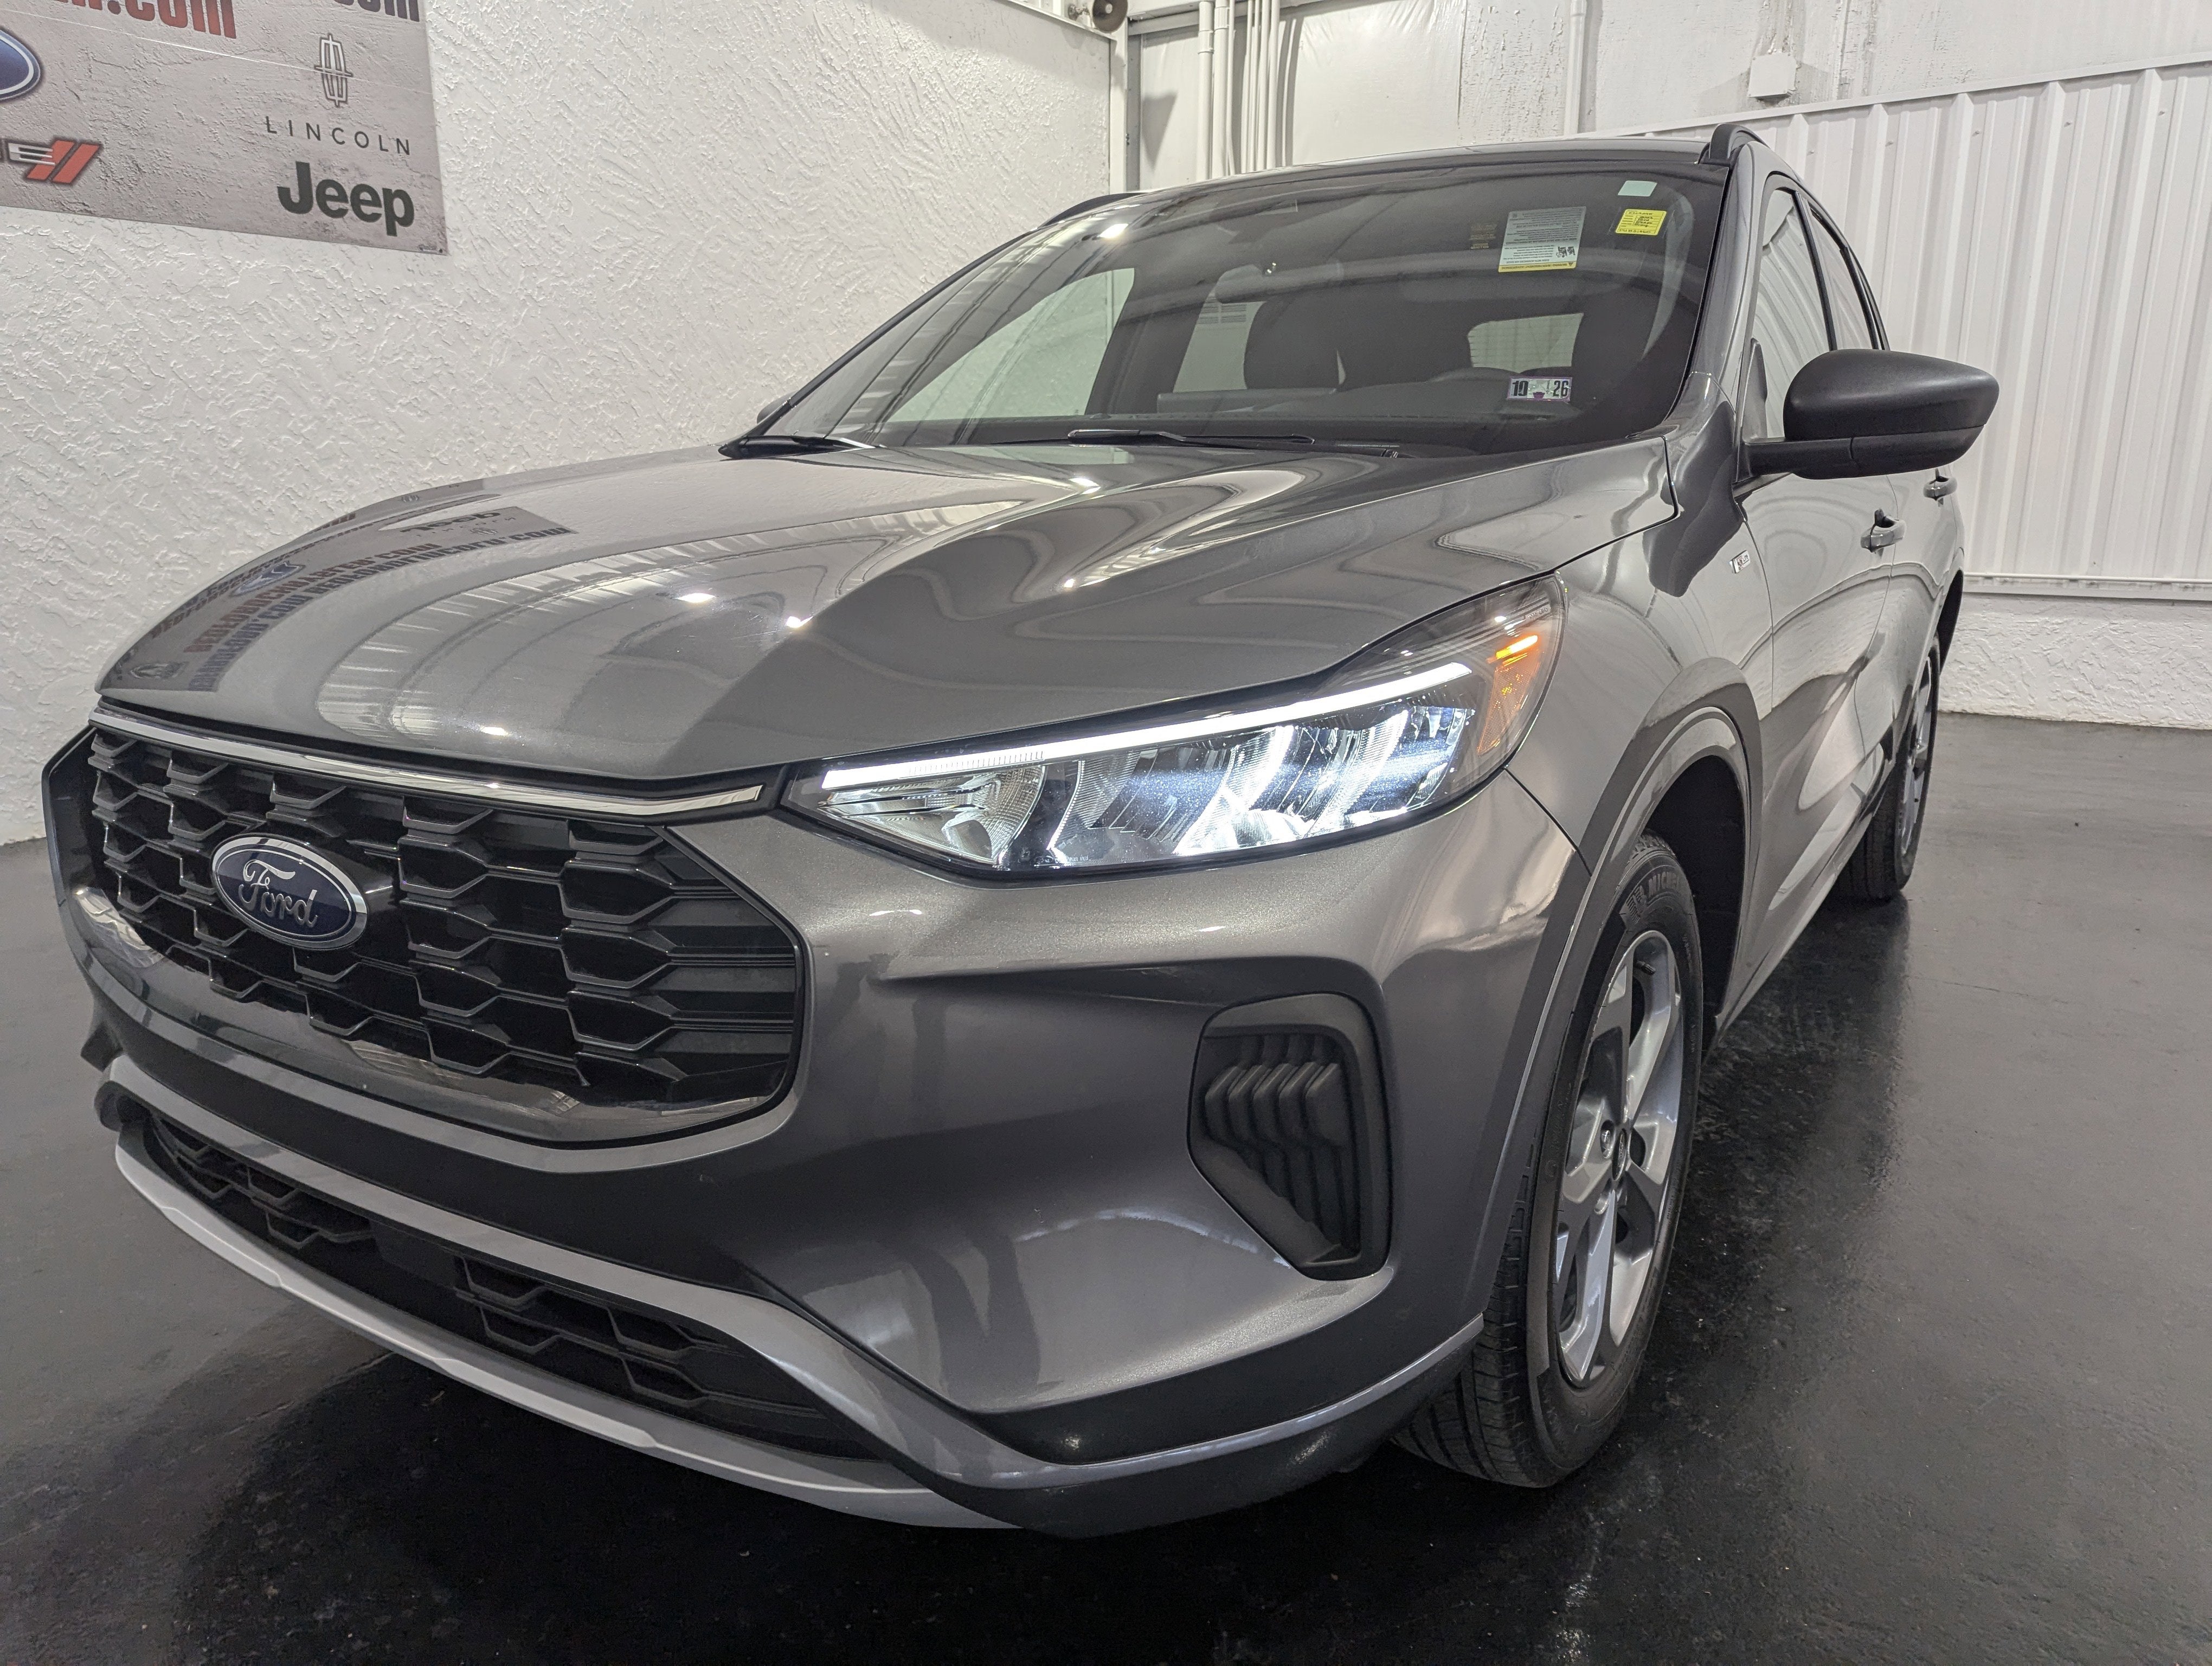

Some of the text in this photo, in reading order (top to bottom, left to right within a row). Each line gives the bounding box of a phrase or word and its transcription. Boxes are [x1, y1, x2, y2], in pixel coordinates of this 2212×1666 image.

[265, 116, 410, 156] LINCOLN
[276, 161, 415, 237] Jeep
[1513, 380, 1569, 397] 10 26
[238, 859, 318, 928] Ford
